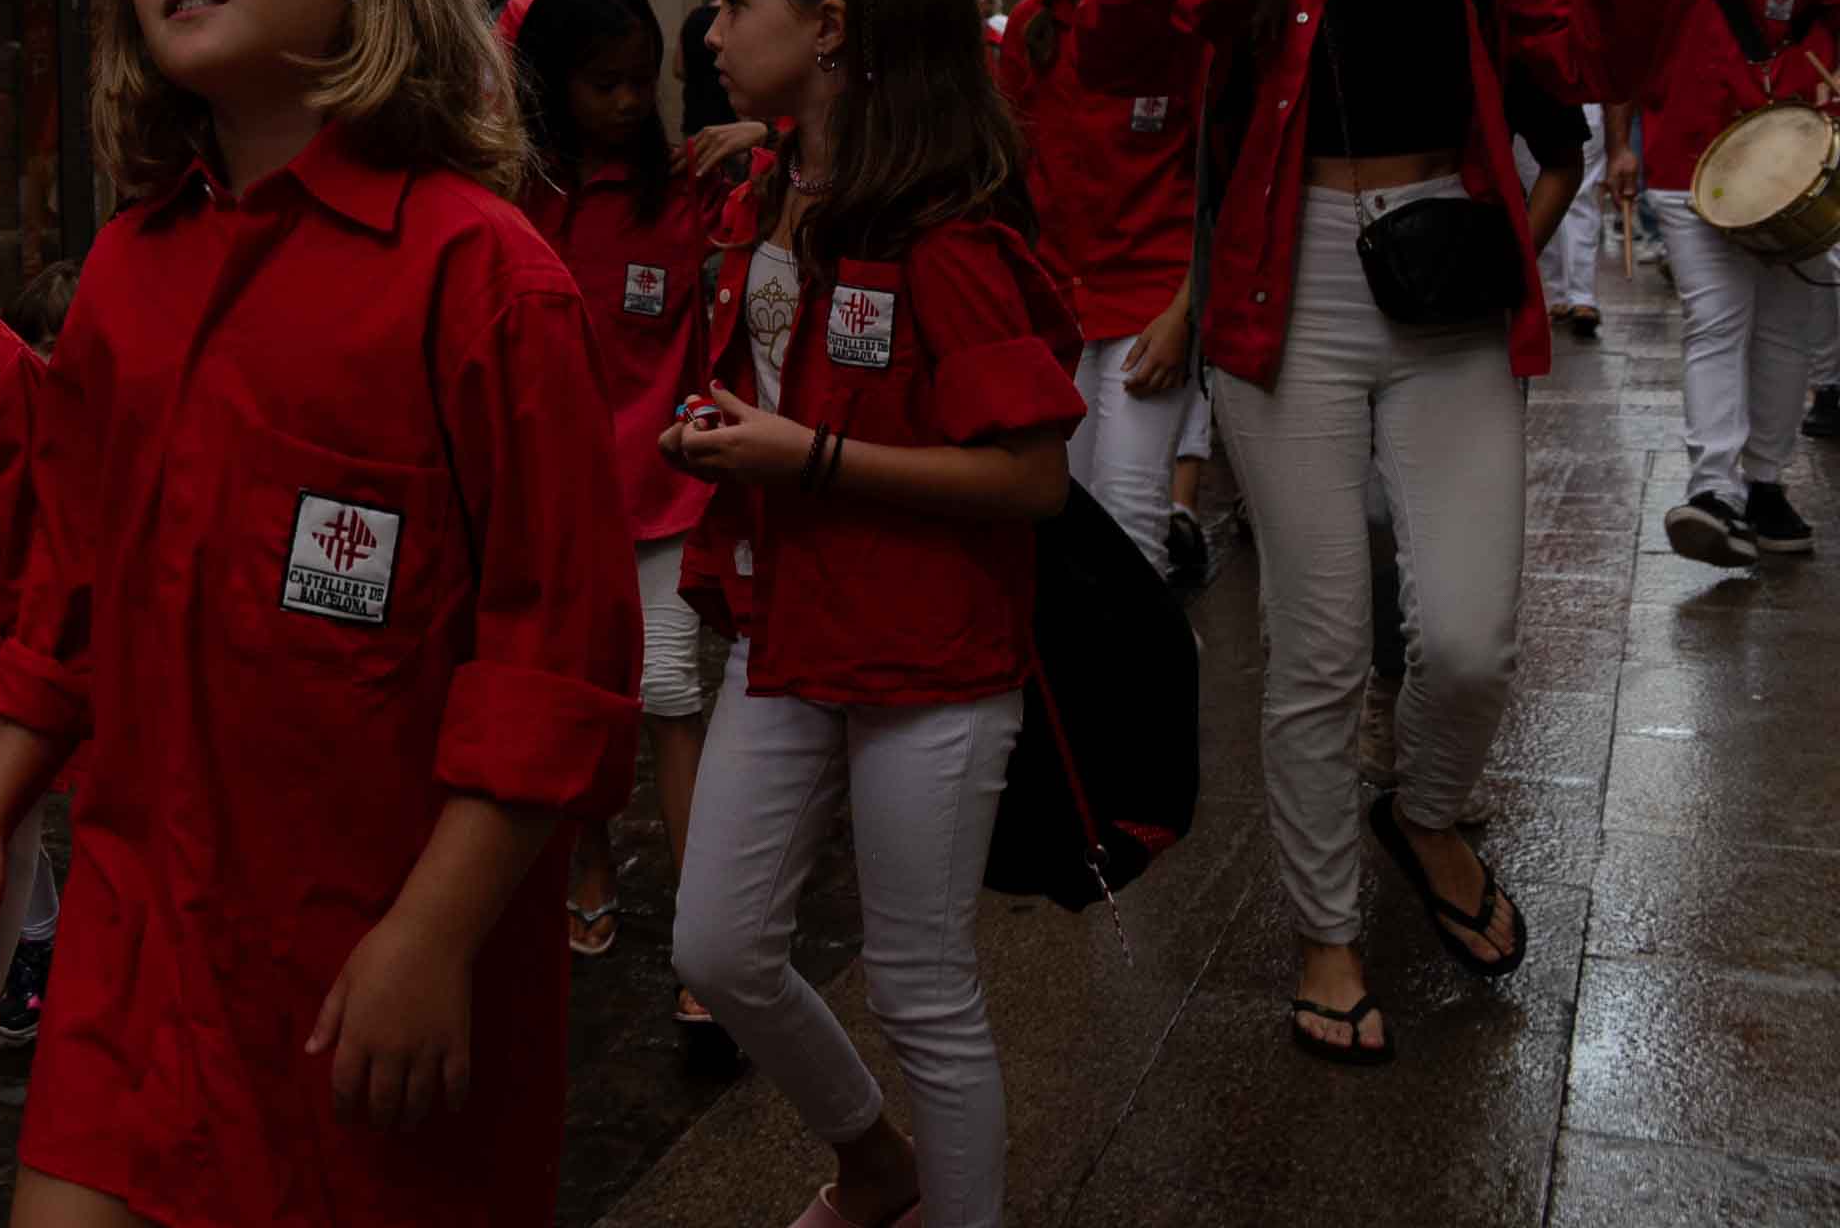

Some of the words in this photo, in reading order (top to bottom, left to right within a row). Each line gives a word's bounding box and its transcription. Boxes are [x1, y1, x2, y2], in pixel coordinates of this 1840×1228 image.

[289, 570, 367, 598] CASTELLERS
[368, 586, 385, 602] DE
[300, 586, 368, 616] BARCELONA
